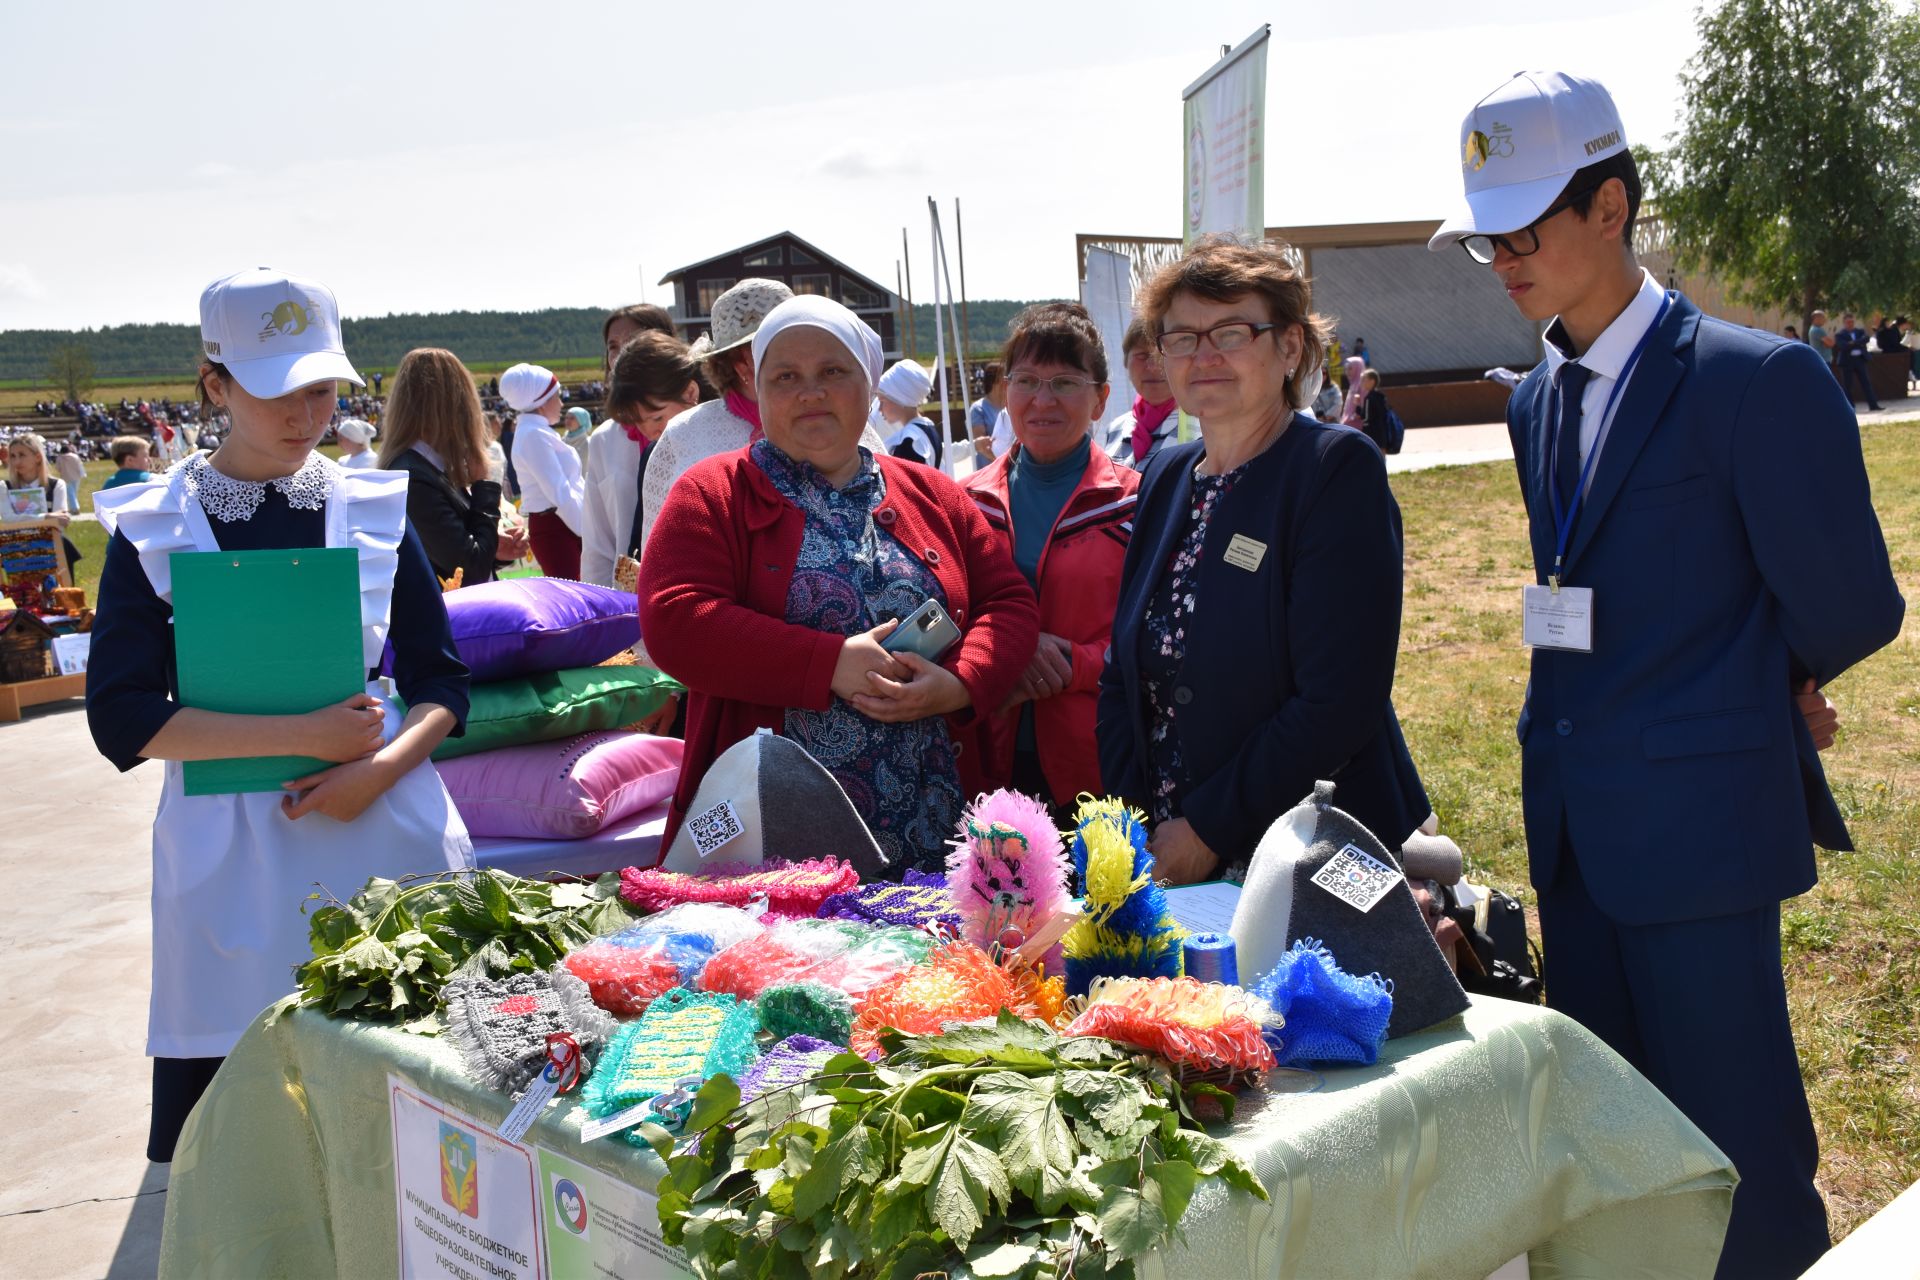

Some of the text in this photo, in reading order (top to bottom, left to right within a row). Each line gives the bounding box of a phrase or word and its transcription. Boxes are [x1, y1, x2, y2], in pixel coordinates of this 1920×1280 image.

[1584, 129, 1621, 157] КУКМАРА
[405, 1188, 529, 1268] МУНИЦИПАЛЬНОЕ БЮДЖЕТНОЕ
